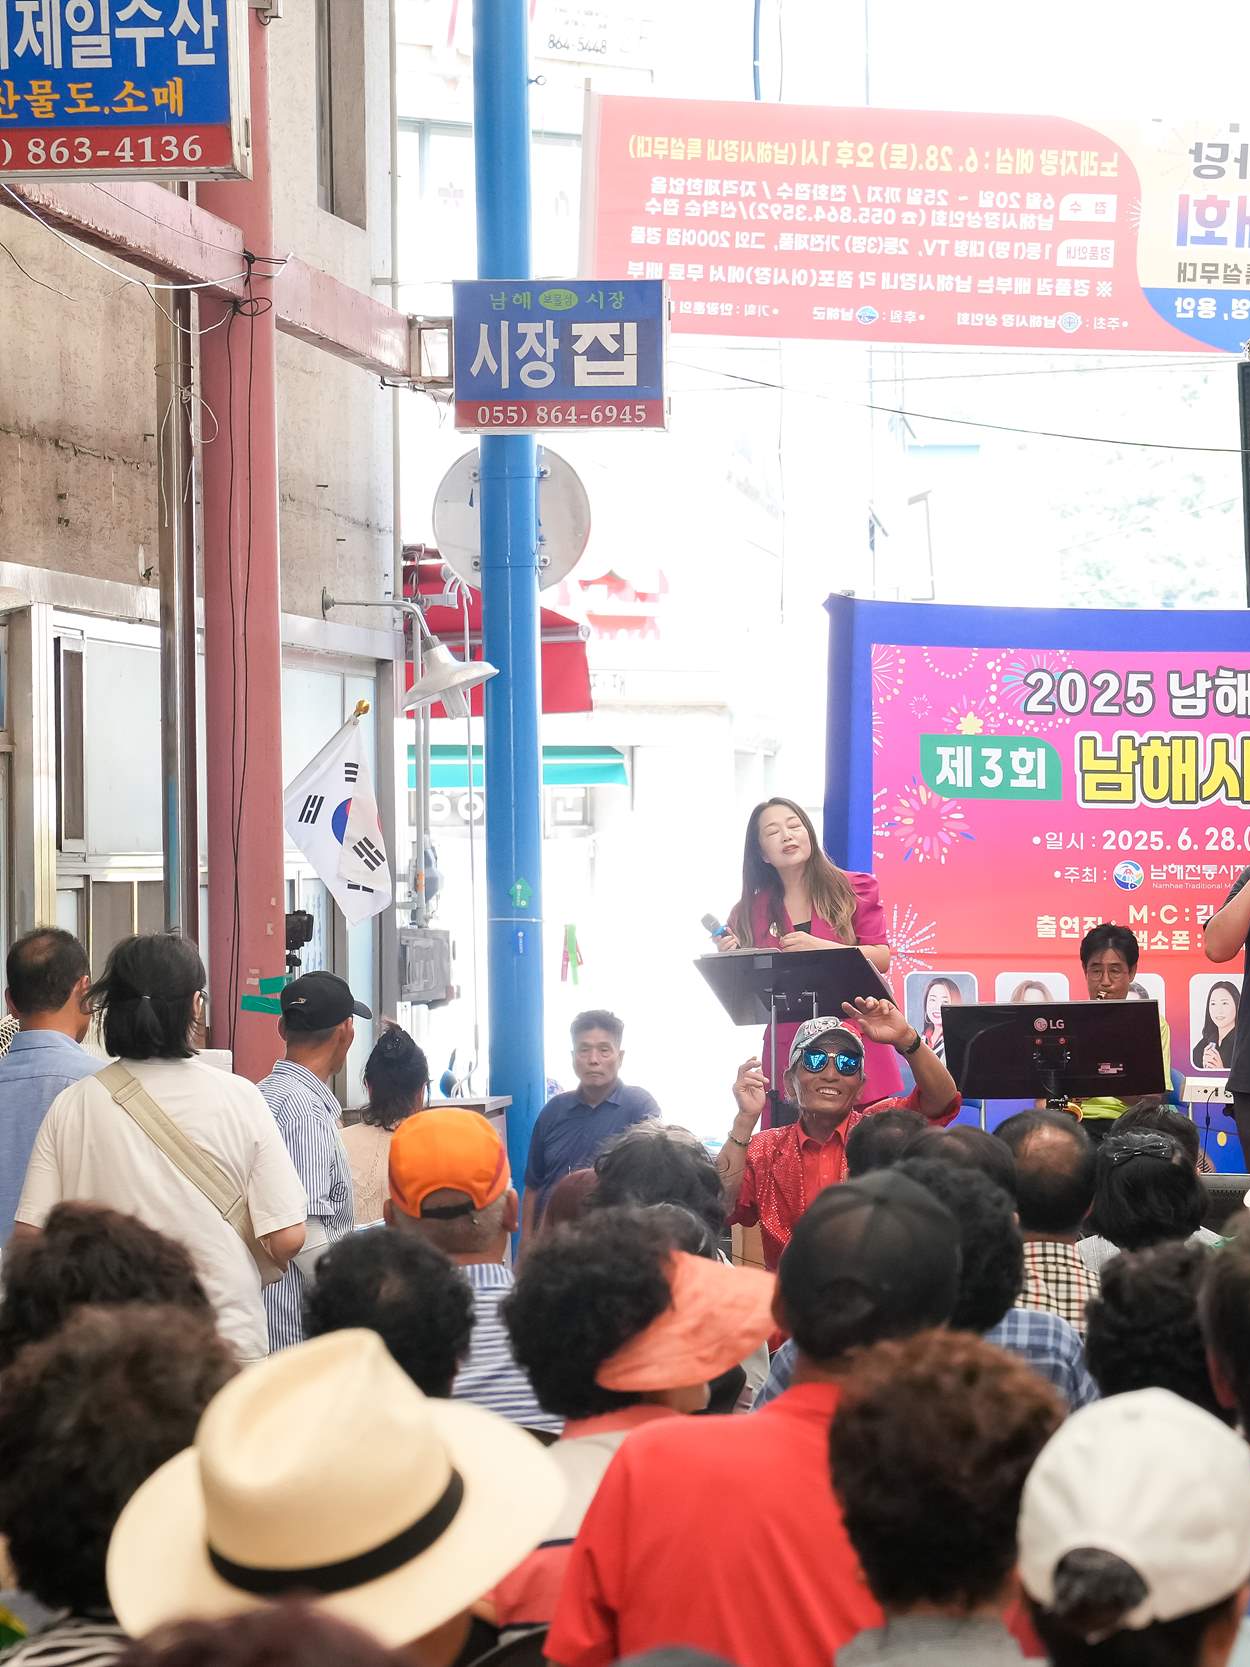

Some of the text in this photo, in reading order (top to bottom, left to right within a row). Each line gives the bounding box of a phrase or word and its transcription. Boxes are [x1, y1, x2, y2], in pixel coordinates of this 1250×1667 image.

[0, 0, 219, 69] 제일수산
[27, 136, 203, 164] 863-4136
[489, 291, 532, 311] 남해
[585, 290, 625, 311] 시장
[477, 405, 647, 425] 055) 864-6945
[1023, 668, 1155, 717] 2025
[1102, 830, 1171, 851] 2025.
[1049, 1019, 1065, 1029] LG
